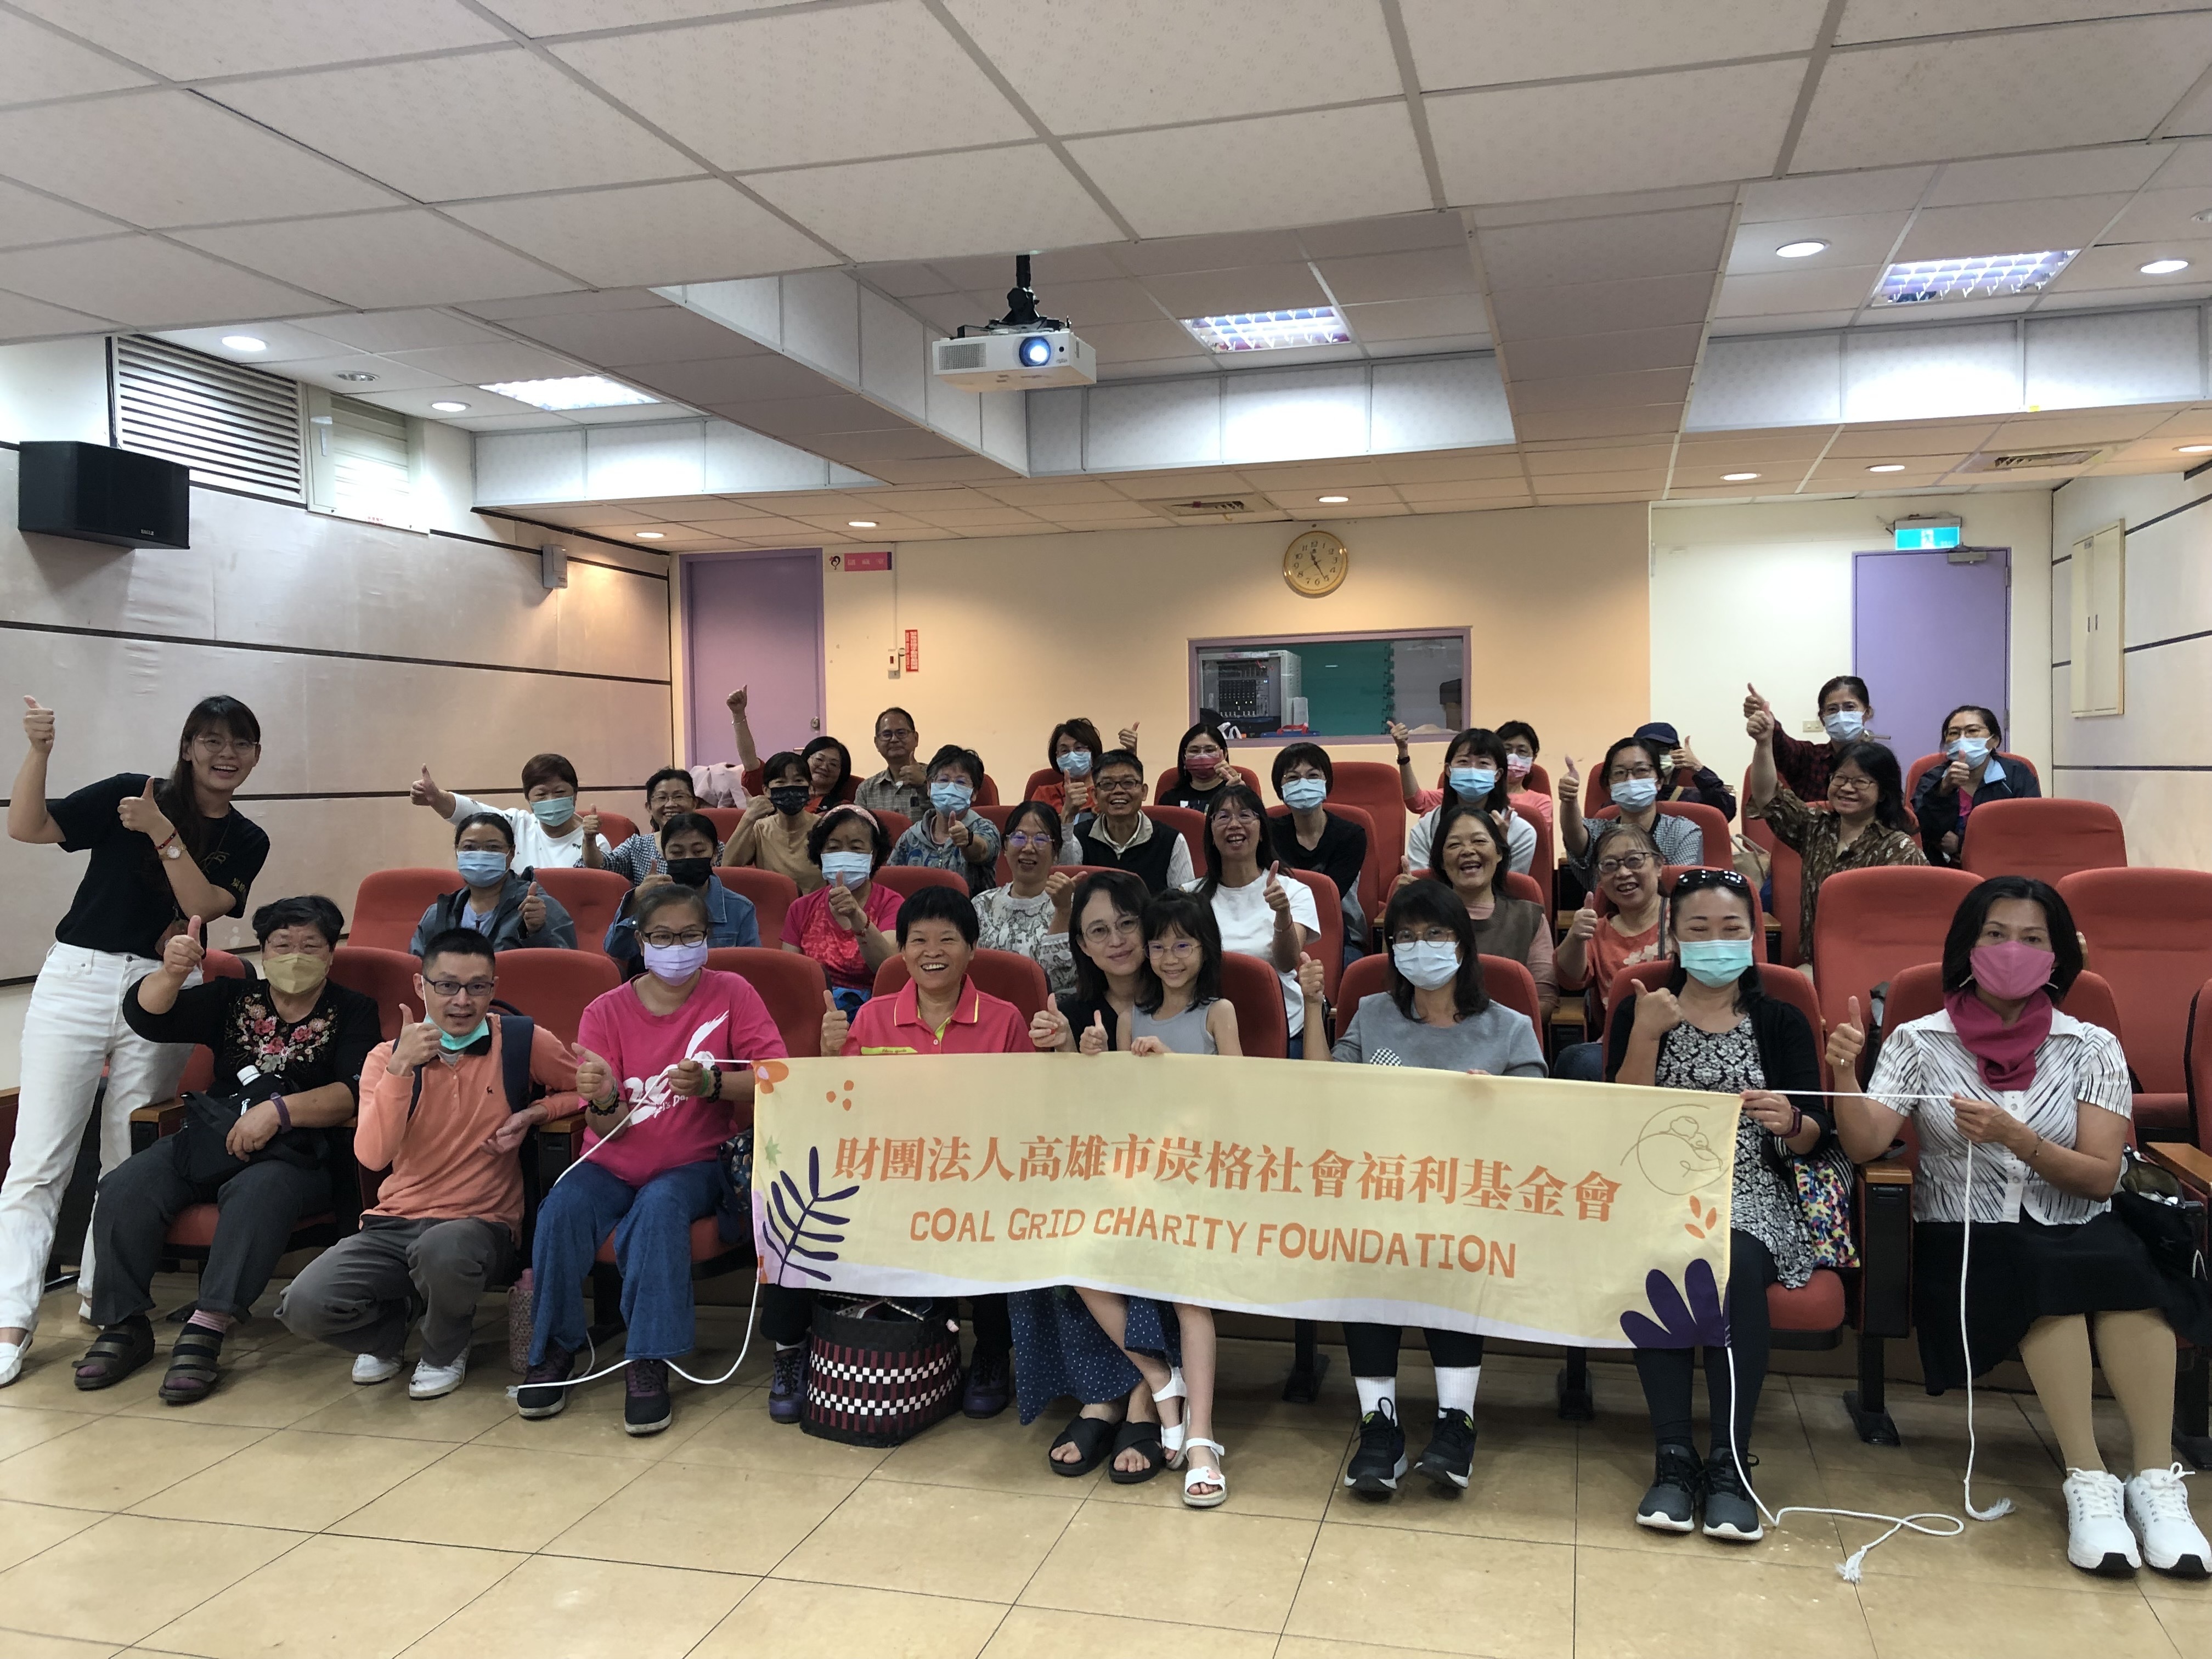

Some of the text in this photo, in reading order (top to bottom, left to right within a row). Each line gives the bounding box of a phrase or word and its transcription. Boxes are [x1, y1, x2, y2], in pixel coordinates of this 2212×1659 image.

[673, 1094, 688, 1107] Da
[832, 1133, 1622, 1222] 財團法人高雄市炭格社會福利基金會
[911, 1208, 994, 1241] COAL
[1094, 1207, 1246, 1251] CHARITY
[1257, 1223, 1515, 1278] FOUNDATION
